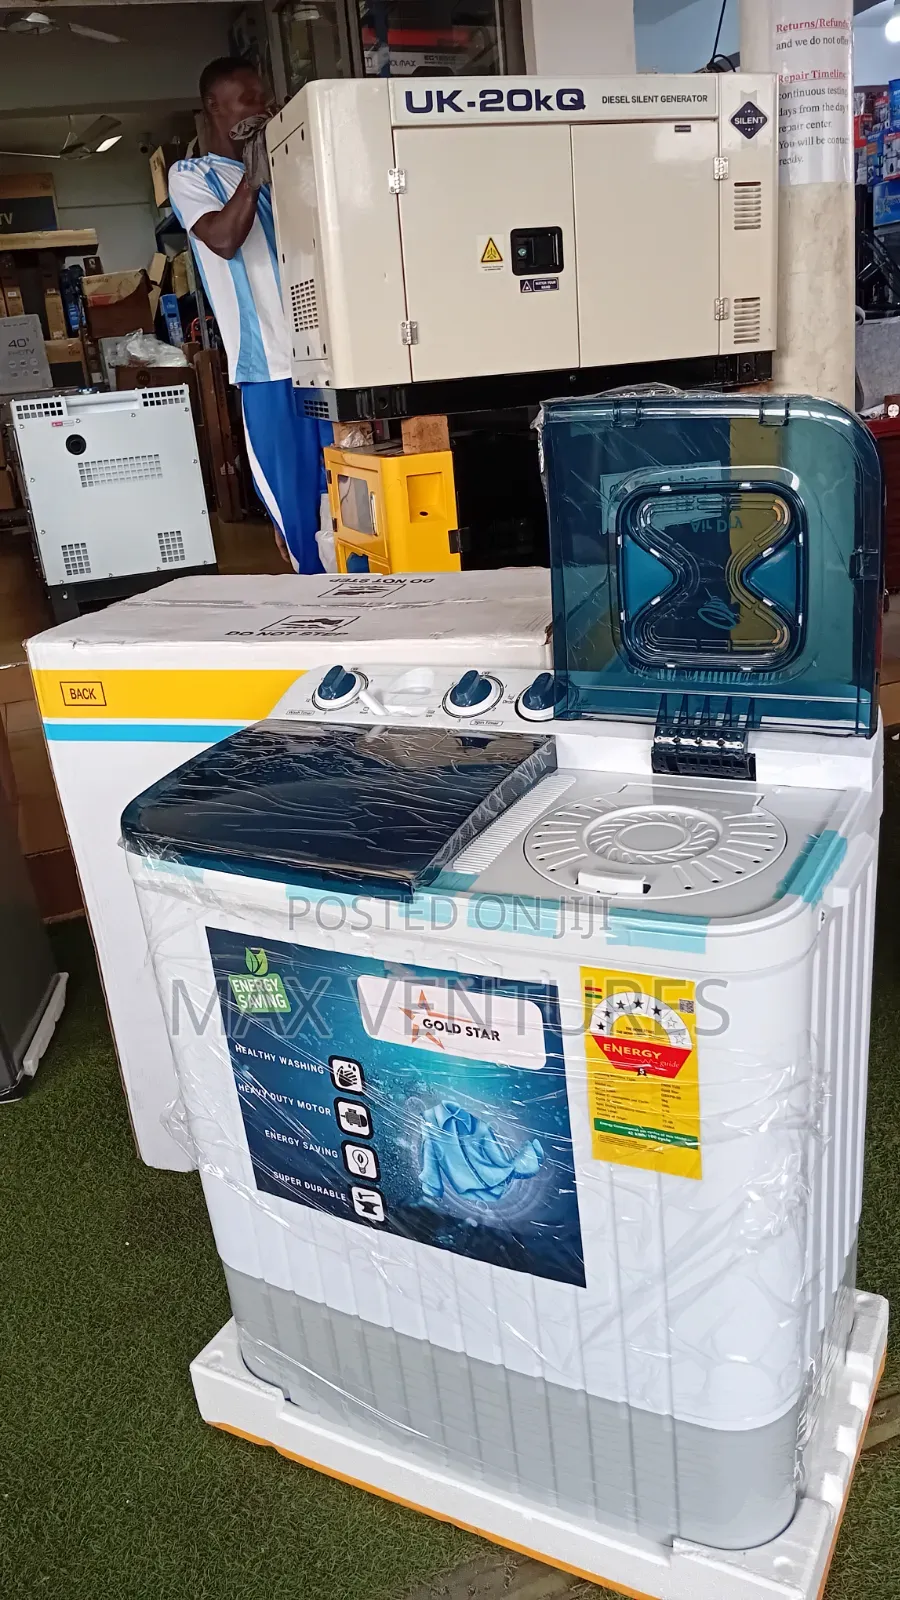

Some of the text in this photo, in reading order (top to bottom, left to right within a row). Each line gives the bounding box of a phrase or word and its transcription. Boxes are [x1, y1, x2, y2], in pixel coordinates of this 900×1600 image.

[776, 39, 793, 50] and
[809, 36, 821, 45] do
[778, 71, 809, 83] Repair
[405, 88, 709, 114] UK-20kQ DIESEL SILENT GENERATOR
[799, 104, 820, 114] from
[822, 102, 834, 111] the
[734, 116, 765, 125] SILENT
[779, 140, 795, 150] You
[797, 136, 814, 146] will
[816, 136, 825, 145] be
[69, 687, 98, 700] BACK
[231, 978, 279, 993] ENERGY
[238, 993, 287, 1009] SAVING
[422, 1018, 501, 1041] GOLD STAR
[603, 1043, 662, 1060] ENERGY
[235, 1045, 325, 1075] HEALTHY WASHING
[659, 1060, 680, 1068] guide
[238, 1083, 332, 1116] HEAVY DUTY MOTOR
[264, 1129, 339, 1158] ENERGY SAVING
[272, 1171, 347, 1201] SUPER DURABLE
